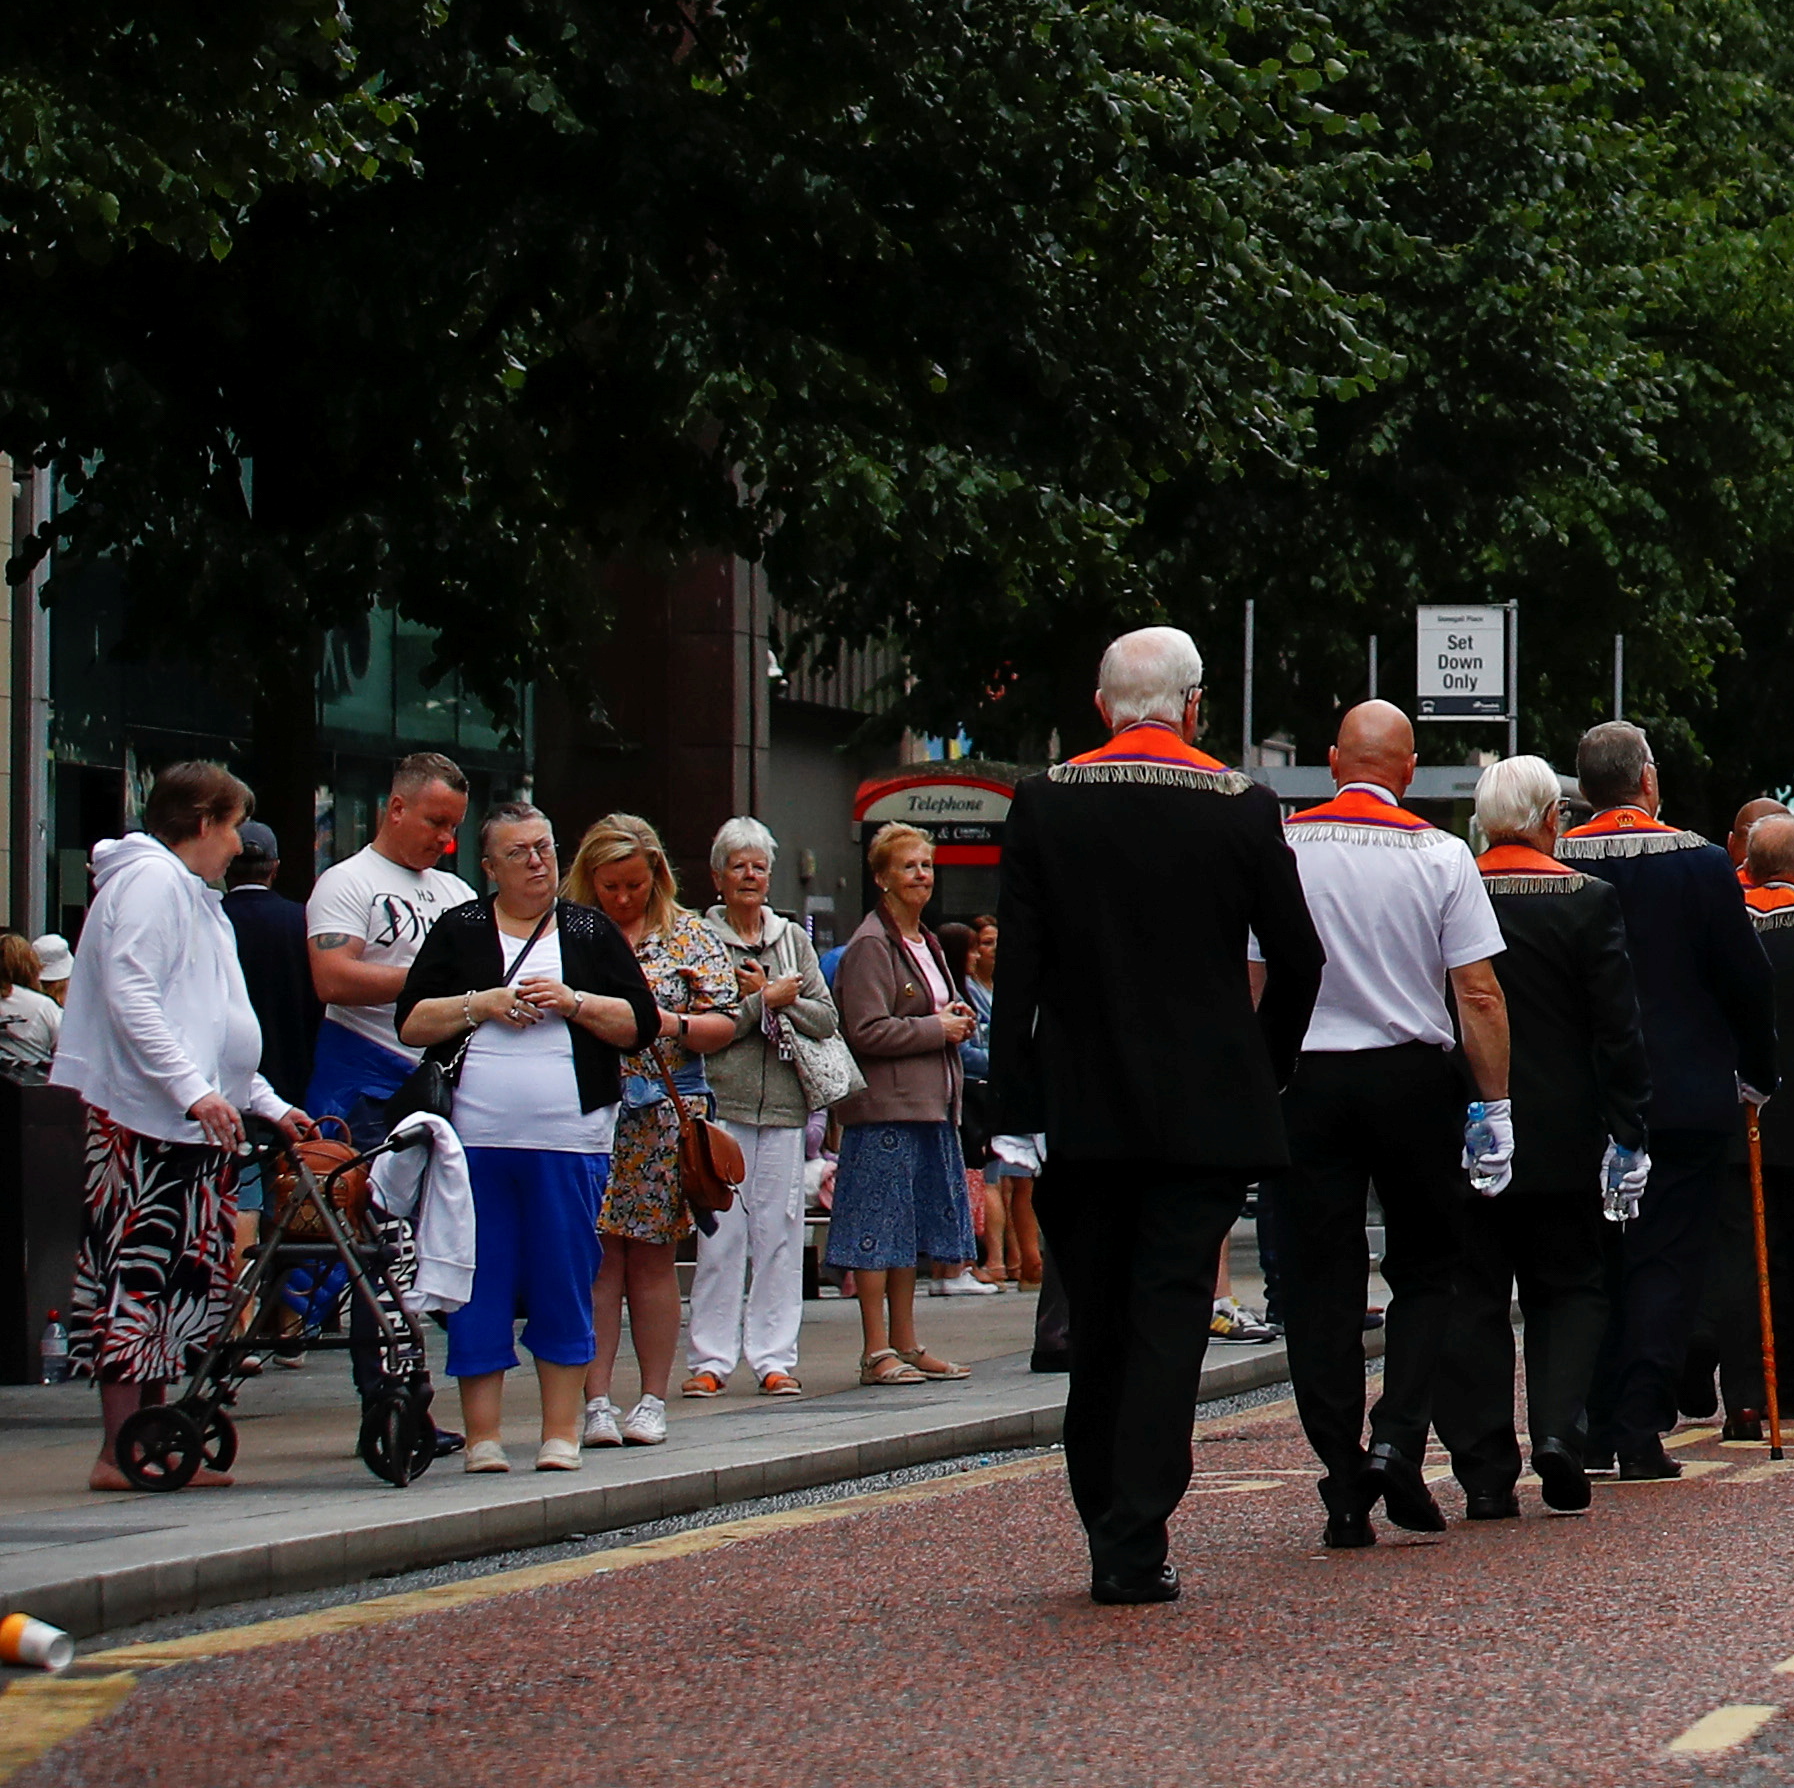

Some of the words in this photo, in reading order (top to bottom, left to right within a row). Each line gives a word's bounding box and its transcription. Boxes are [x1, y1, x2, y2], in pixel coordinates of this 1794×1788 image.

[1447, 634, 1473, 650] Set
[1438, 654, 1483, 669] Down
[1443, 673, 1478, 692] Only
[908, 795, 984, 813] Telephone
